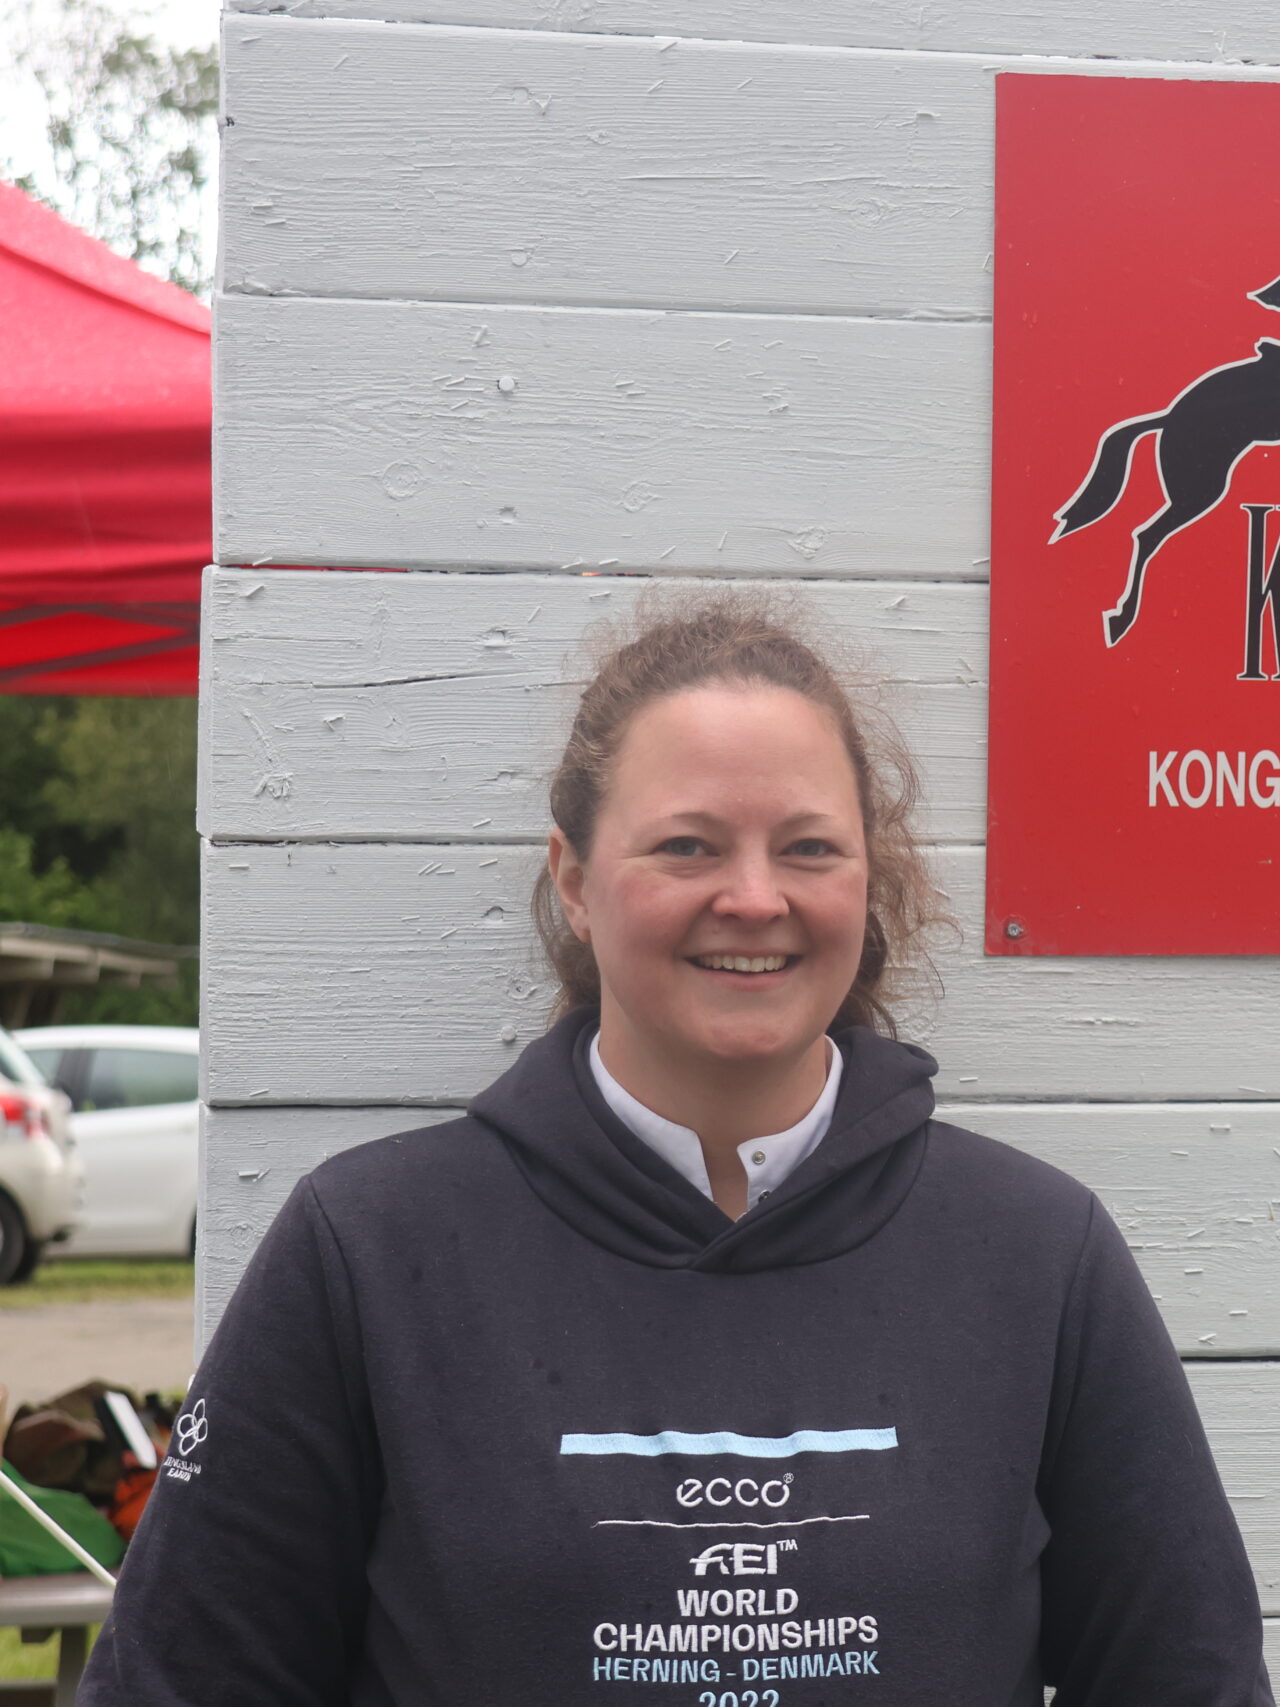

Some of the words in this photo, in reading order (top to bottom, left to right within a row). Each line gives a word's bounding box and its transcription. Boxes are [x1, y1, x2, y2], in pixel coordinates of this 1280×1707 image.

[677, 1588, 799, 1618] WORLD
[592, 1615, 880, 1653] CHAMPIONSHIPS
[593, 1656, 721, 1684] HERNING
[742, 1650, 880, 1682] DENMARK
